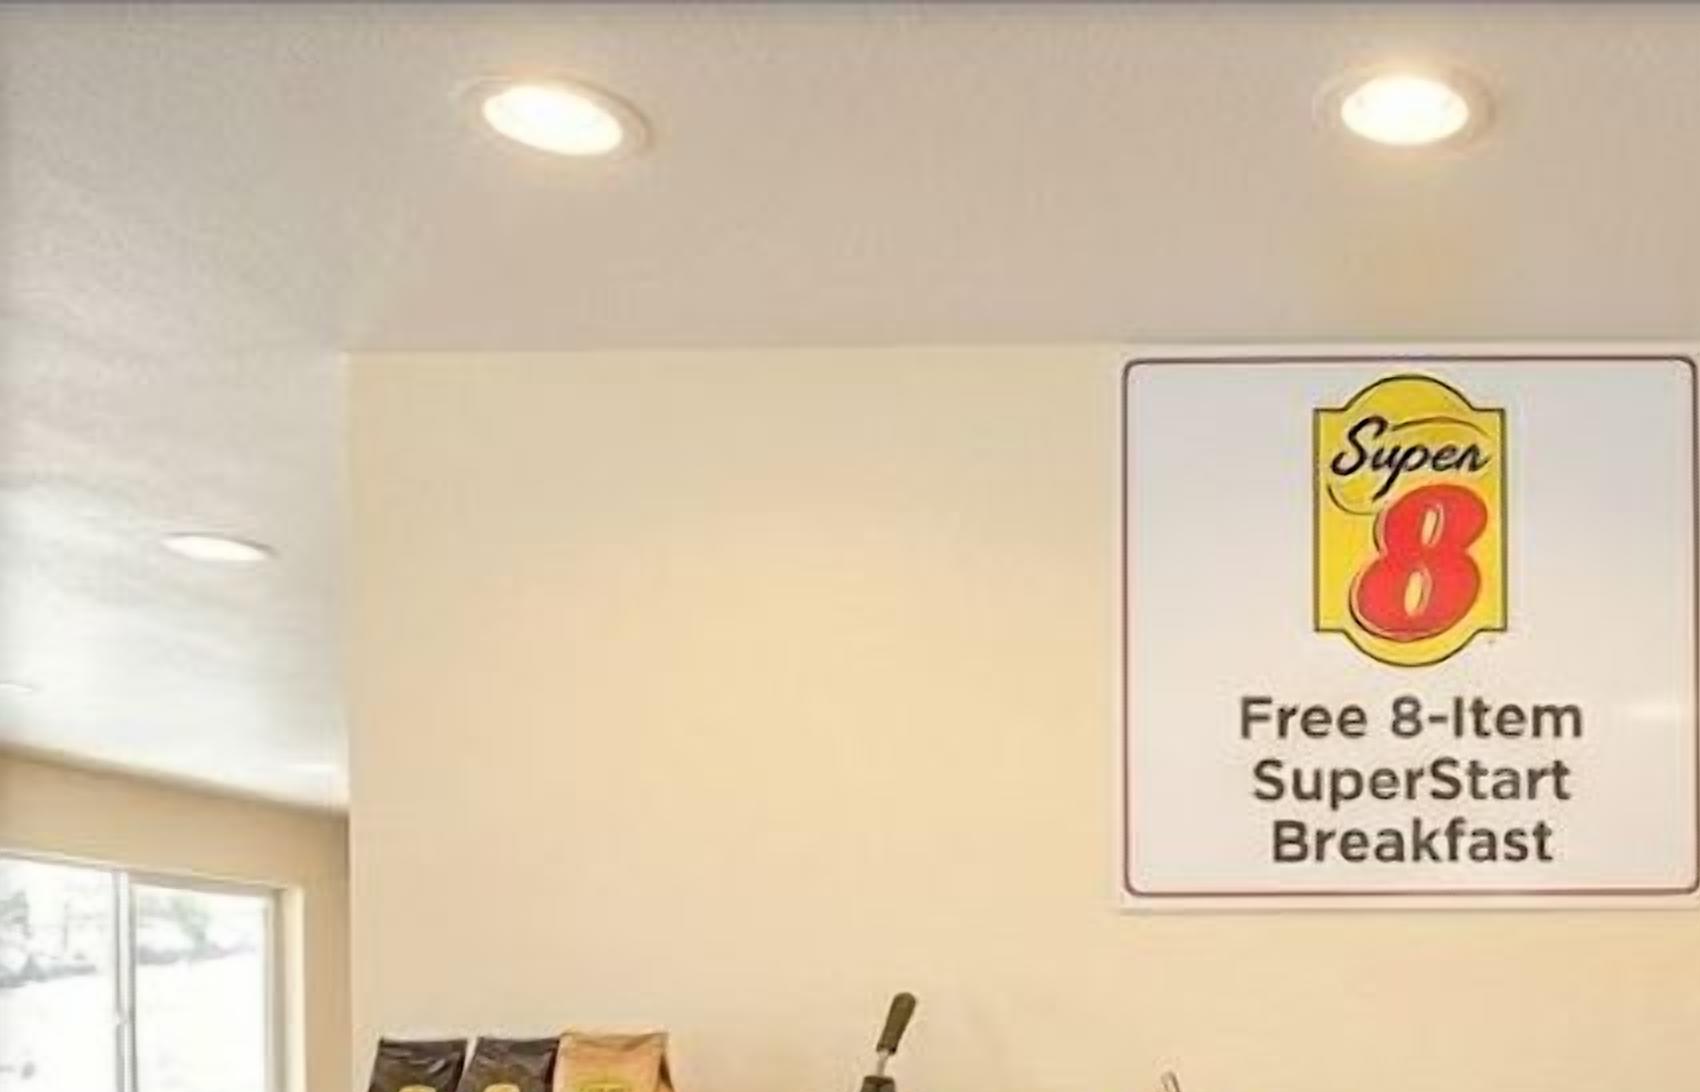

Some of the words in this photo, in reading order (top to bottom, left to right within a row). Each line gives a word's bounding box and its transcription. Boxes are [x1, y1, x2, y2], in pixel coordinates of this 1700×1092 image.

[1331, 416, 1490, 501] Super
[1350, 483, 1489, 642] 8
[1240, 695, 1368, 739] Free
[1390, 695, 1583, 739] 8-Item
[1252, 757, 1572, 810] SuperStart
[1272, 817, 1554, 863] Breakfast
